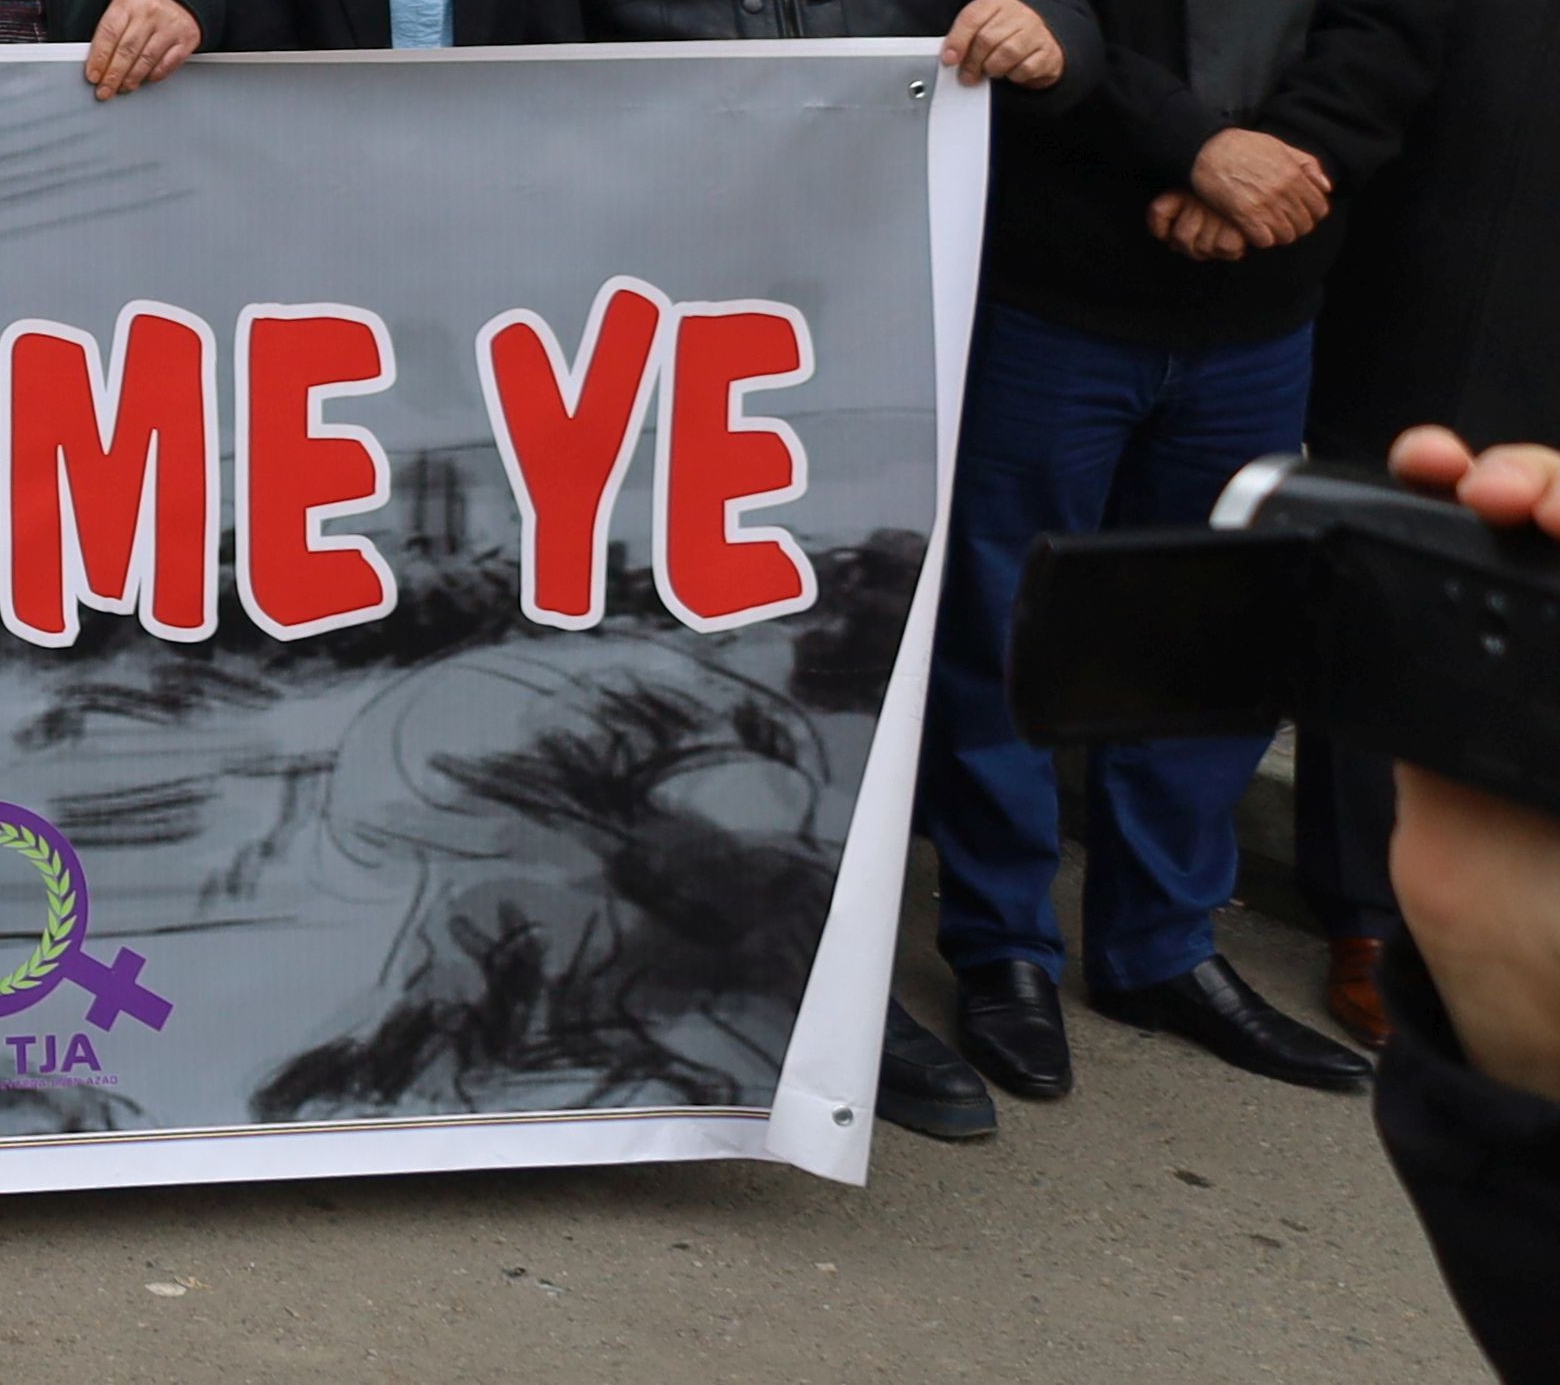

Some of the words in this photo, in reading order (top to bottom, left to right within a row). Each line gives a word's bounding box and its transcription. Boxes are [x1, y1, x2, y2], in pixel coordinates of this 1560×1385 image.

[0, 302, 396, 646] ME
[478, 276, 816, 636] YE
[5, 1033, 102, 1075] TJA
